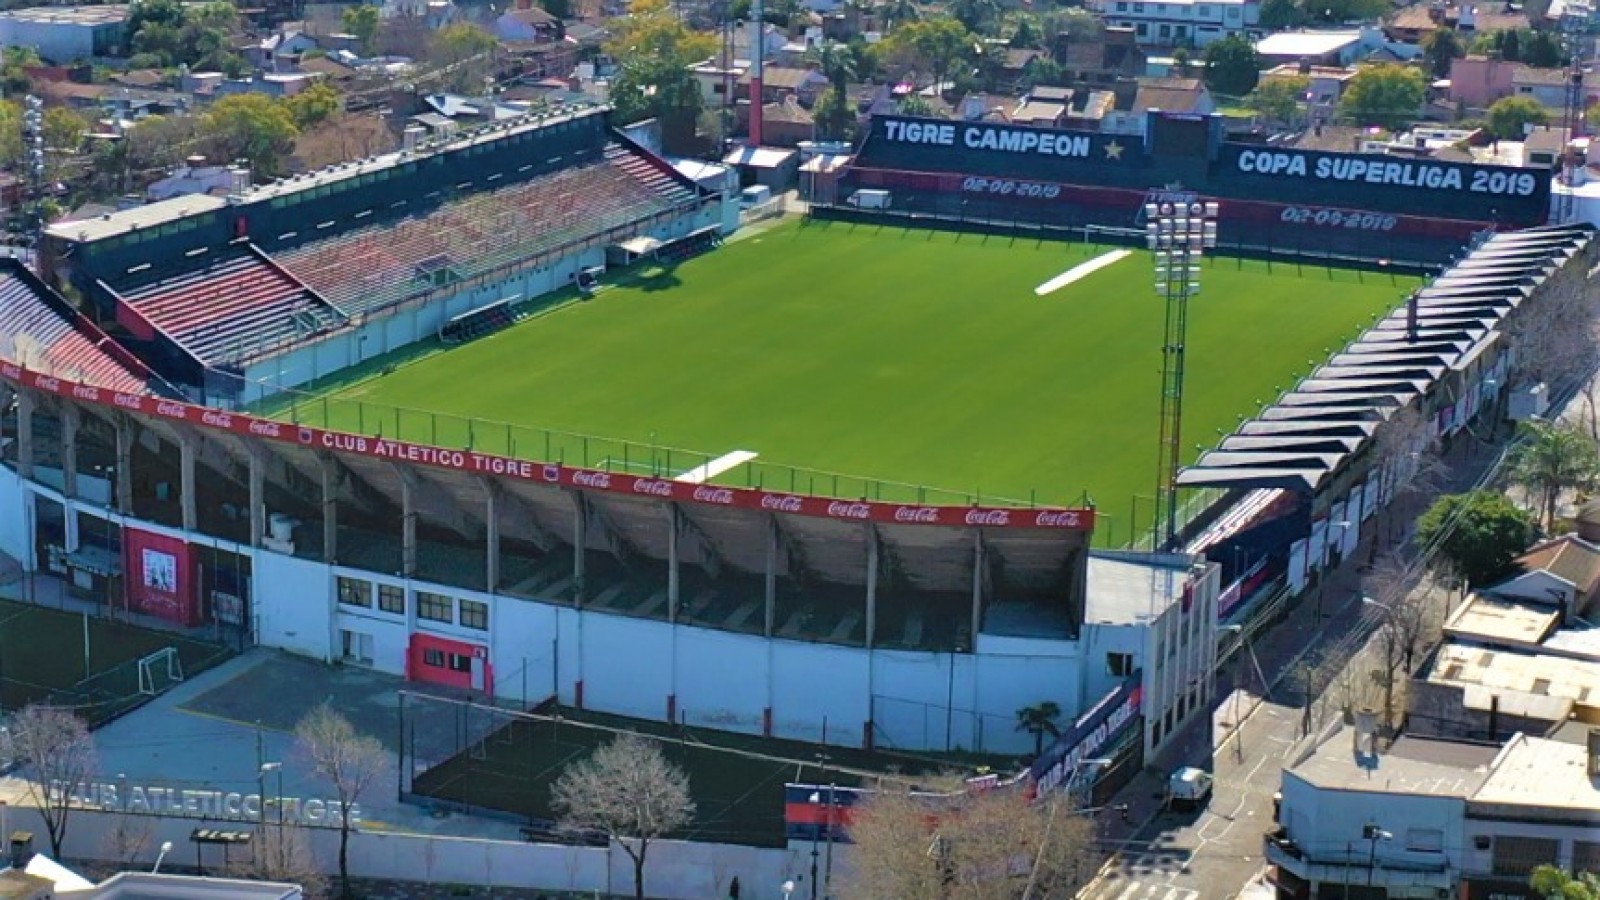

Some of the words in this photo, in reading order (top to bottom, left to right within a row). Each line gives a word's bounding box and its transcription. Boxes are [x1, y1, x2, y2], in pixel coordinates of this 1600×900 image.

[885, 120, 954, 145] TIGRE
[964, 126, 1091, 157] CAMPEON
[1238, 149, 1306, 176] COPA
[1315, 156, 1462, 190] SUPERLIGA
[1470, 171, 1536, 196] 2019
[322, 433, 366, 452] CLUB
[374, 441, 464, 467] ATLETICO
[473, 456, 532, 478] TIGRE
